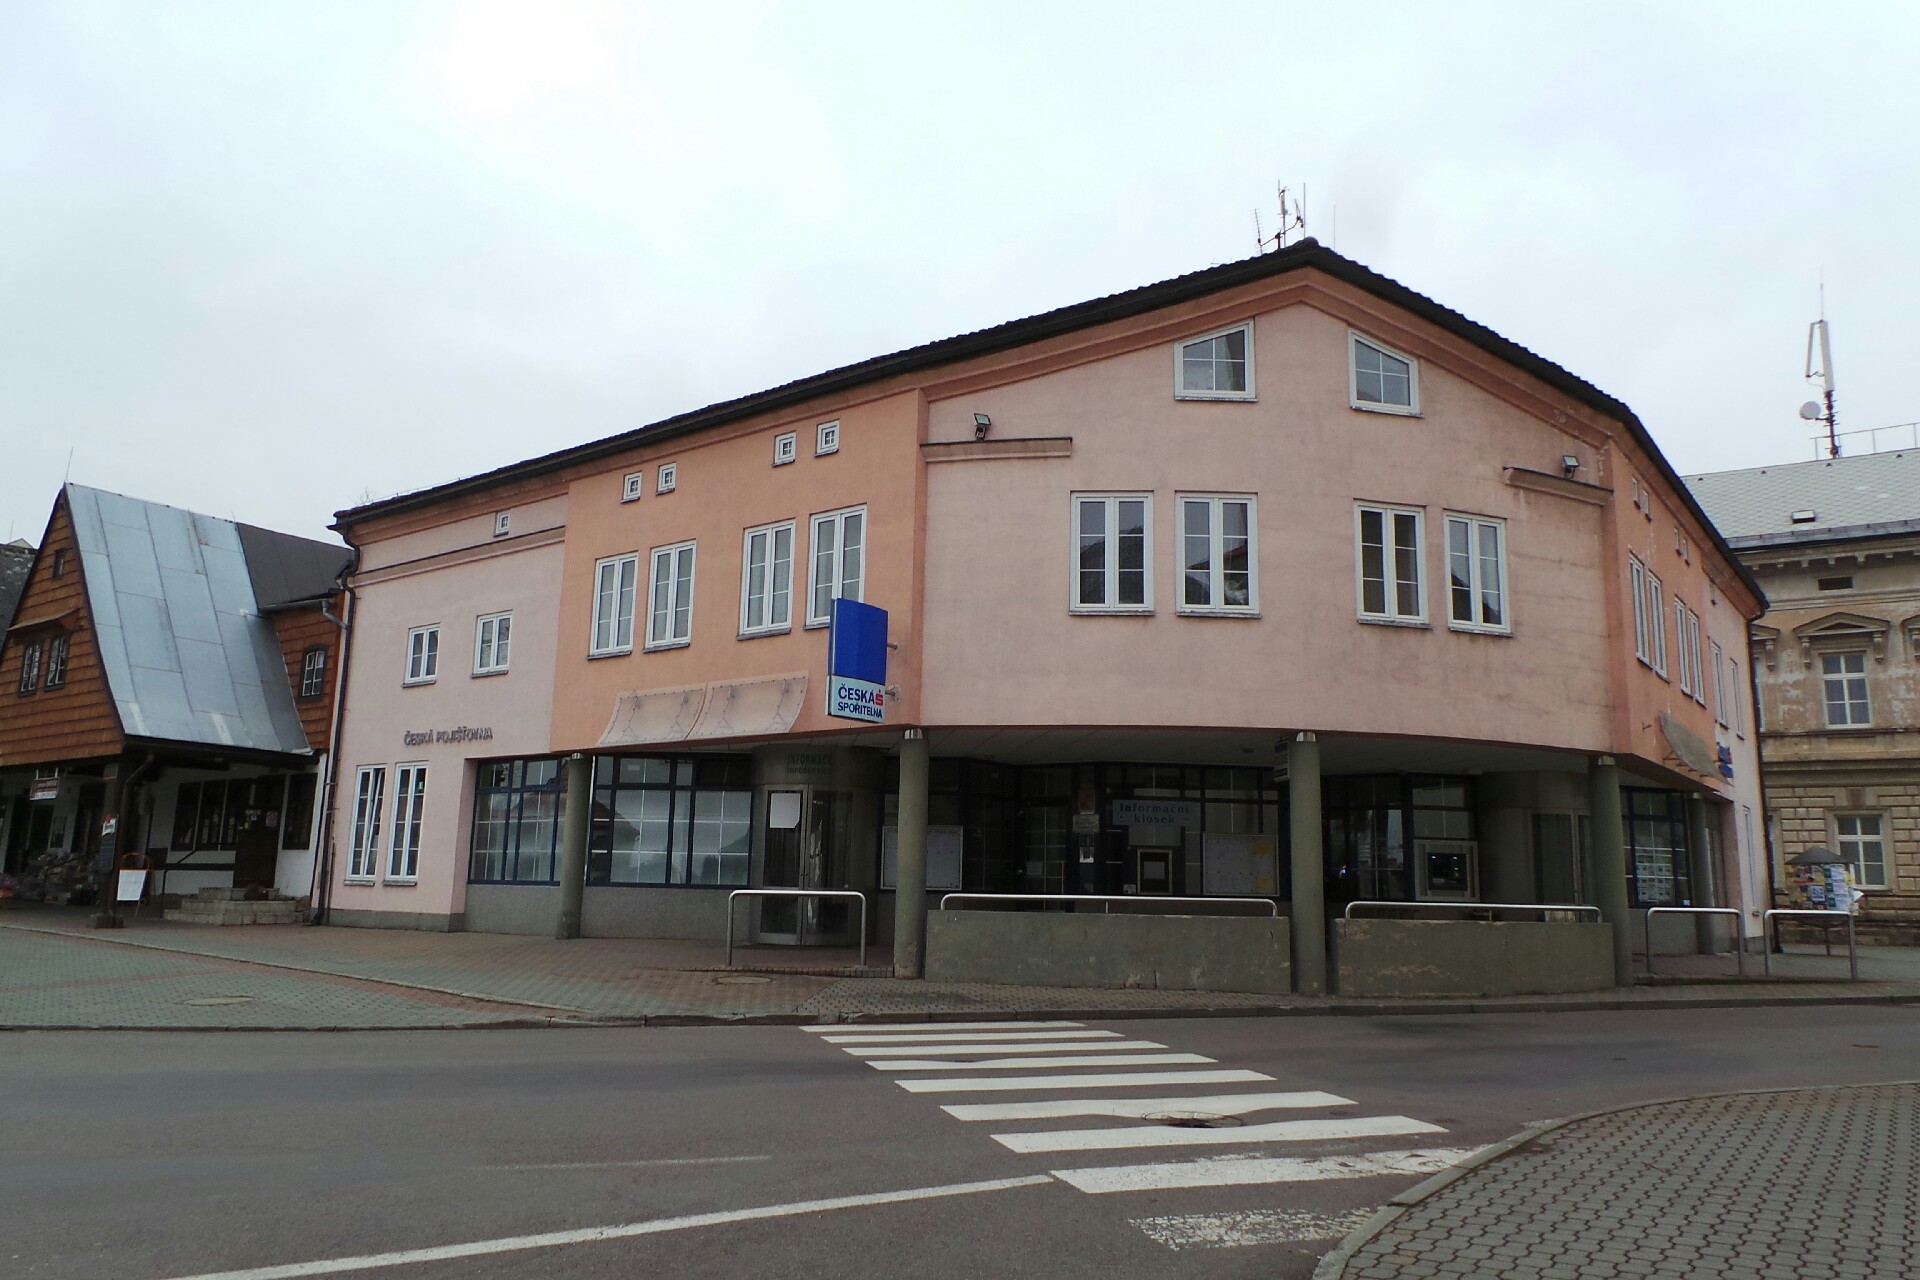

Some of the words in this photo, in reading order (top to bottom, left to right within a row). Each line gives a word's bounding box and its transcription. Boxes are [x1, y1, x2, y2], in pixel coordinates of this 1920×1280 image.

[838, 683, 875, 705] ČESKÁ
[838, 701, 883, 719] SPOŘITELNA
[1134, 814, 1176, 824] kiosek
